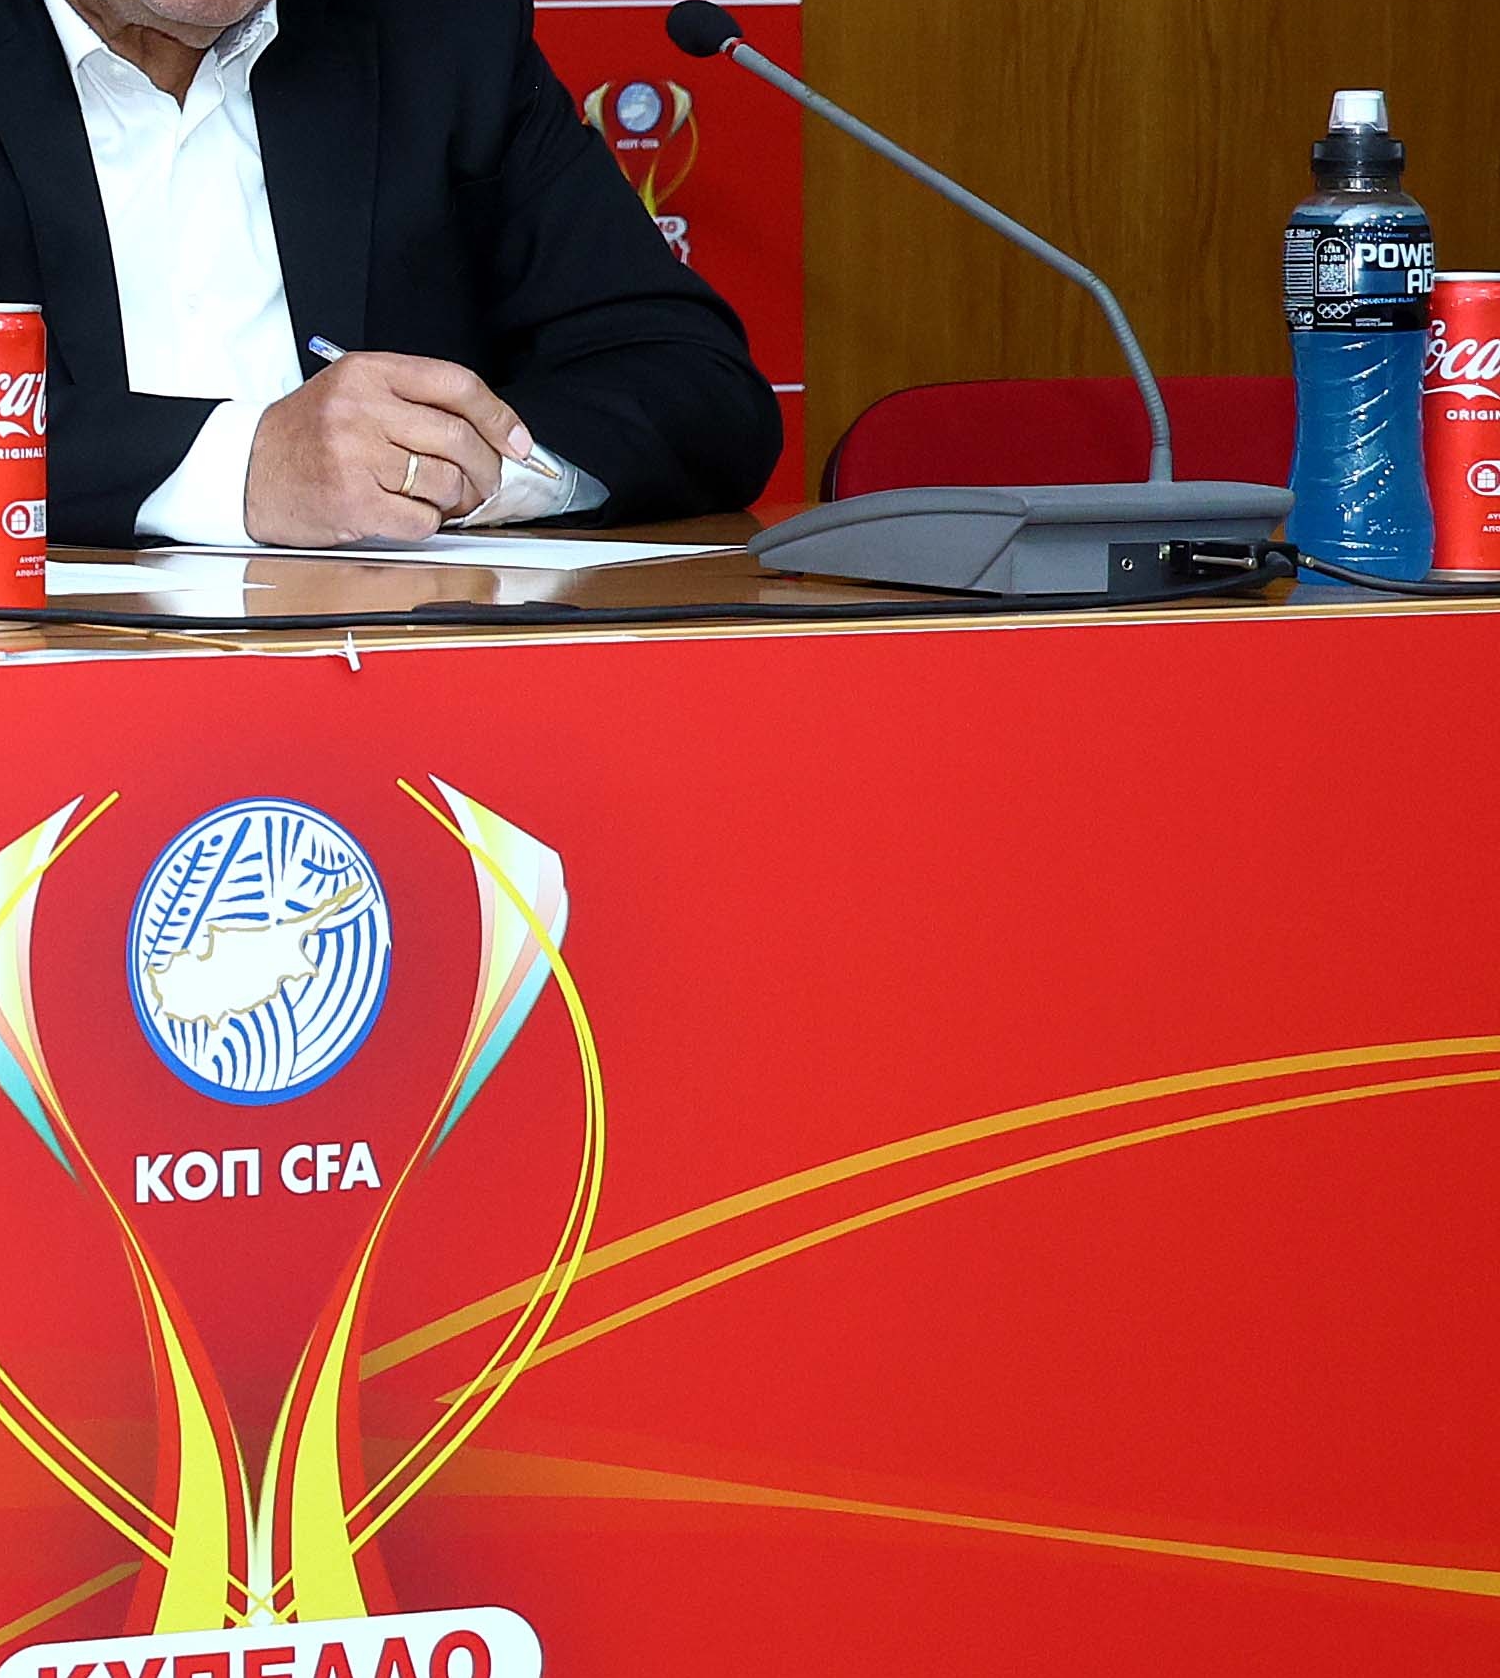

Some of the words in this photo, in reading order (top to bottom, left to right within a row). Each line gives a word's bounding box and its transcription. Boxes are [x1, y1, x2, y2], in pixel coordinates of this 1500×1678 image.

[1353, 243, 1434, 269] POWE
[1407, 268, 1433, 294] AD
[134, 1147, 261, 1204] ΚΟΠ
[280, 1140, 382, 1197] CFA
